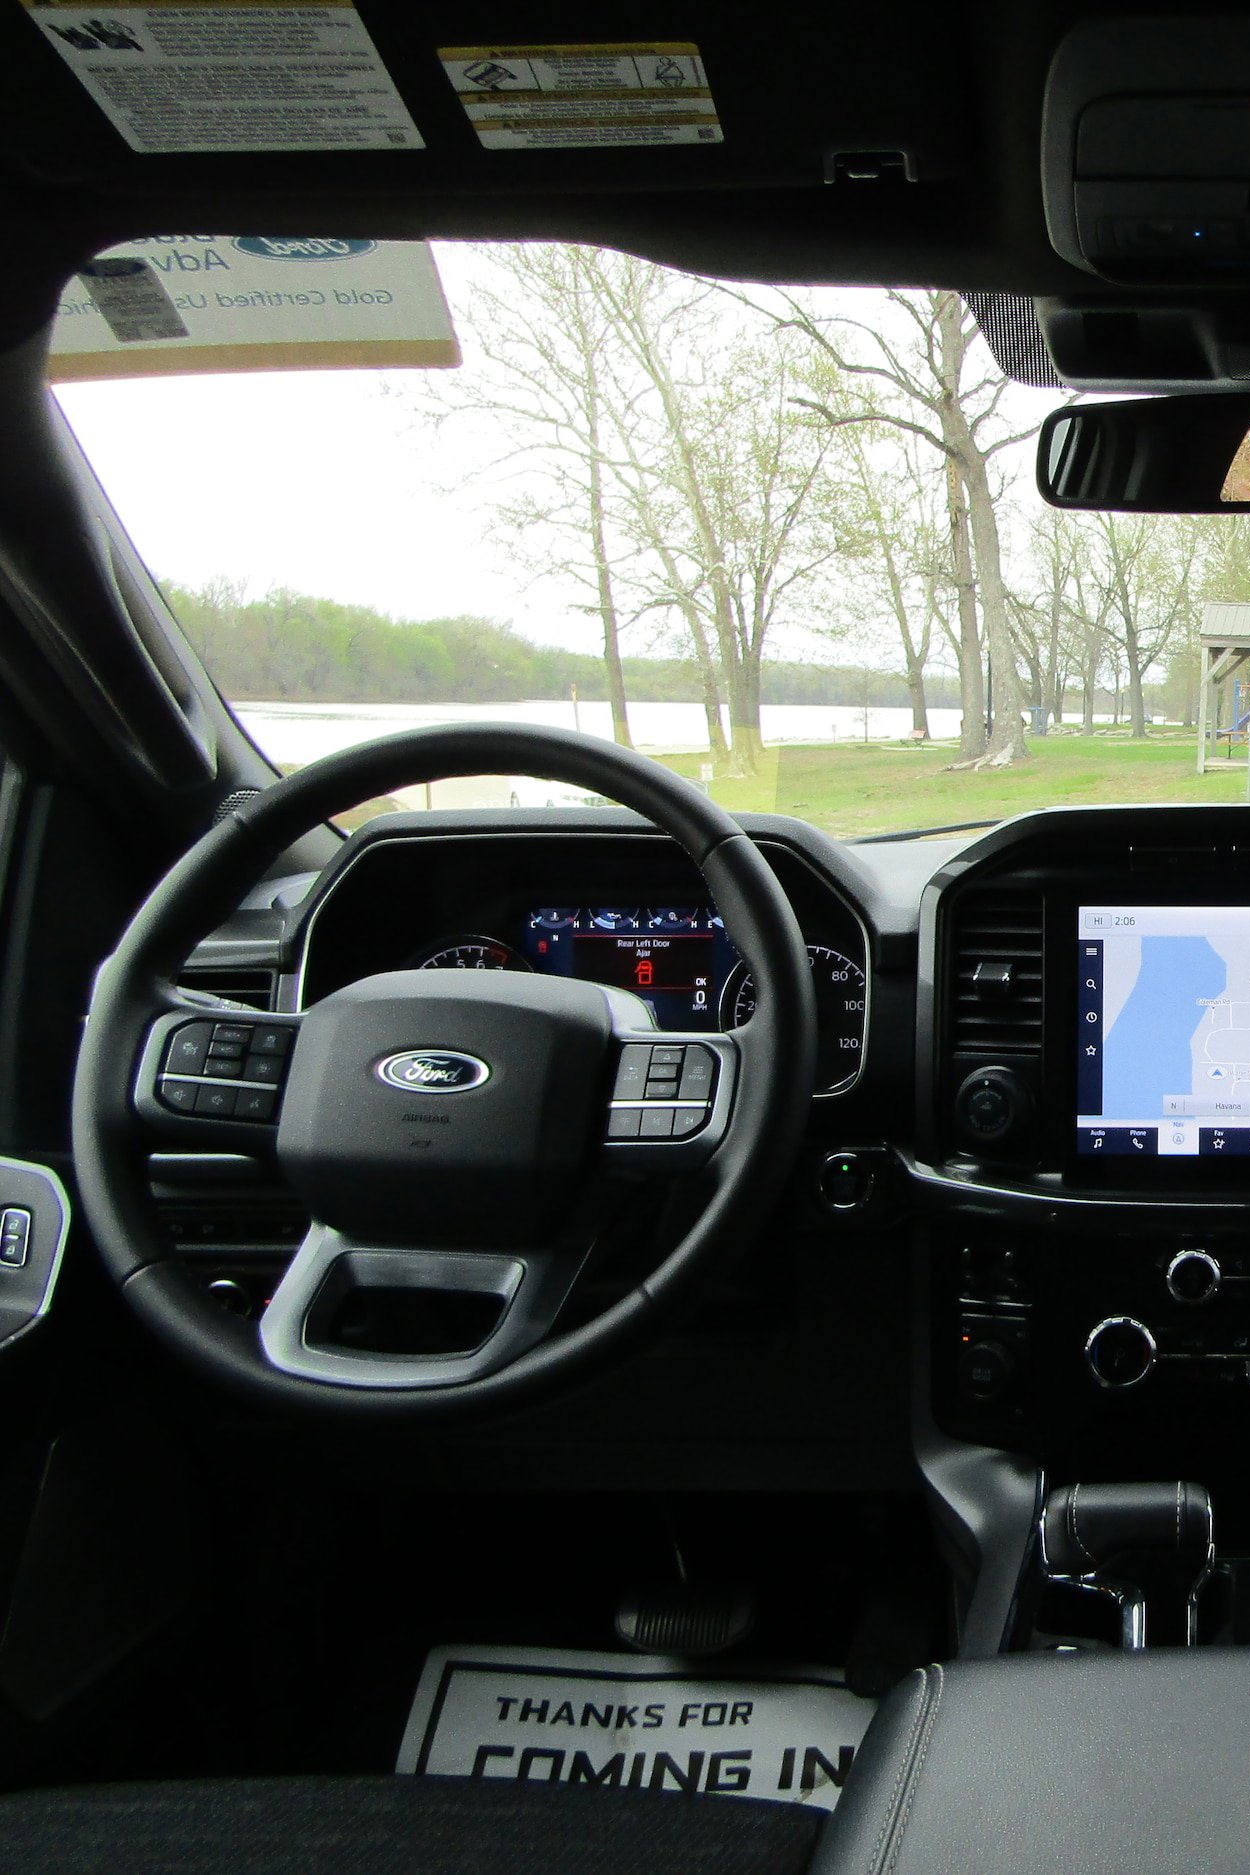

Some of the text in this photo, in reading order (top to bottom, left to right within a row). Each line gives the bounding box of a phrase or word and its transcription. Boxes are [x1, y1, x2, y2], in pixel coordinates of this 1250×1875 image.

[1094, 917, 1103, 925] HI
[1115, 916, 1136, 926] 2:06
[617, 939, 671, 948] Rear Left Door
[636, 949, 651, 959] Ajar
[831, 970, 849, 982] 80
[695, 978, 706, 987] OK
[696, 990, 706, 1004] 0
[692, 1003, 707, 1011] MPH
[838, 1037, 859, 1048] 120
[404, 1058, 463, 1083] Ford
[1215, 1102, 1242, 1110] Havana
[495, 1695, 753, 1729] THANKS FOR
[473, 1745, 855, 1791] COMING IN
